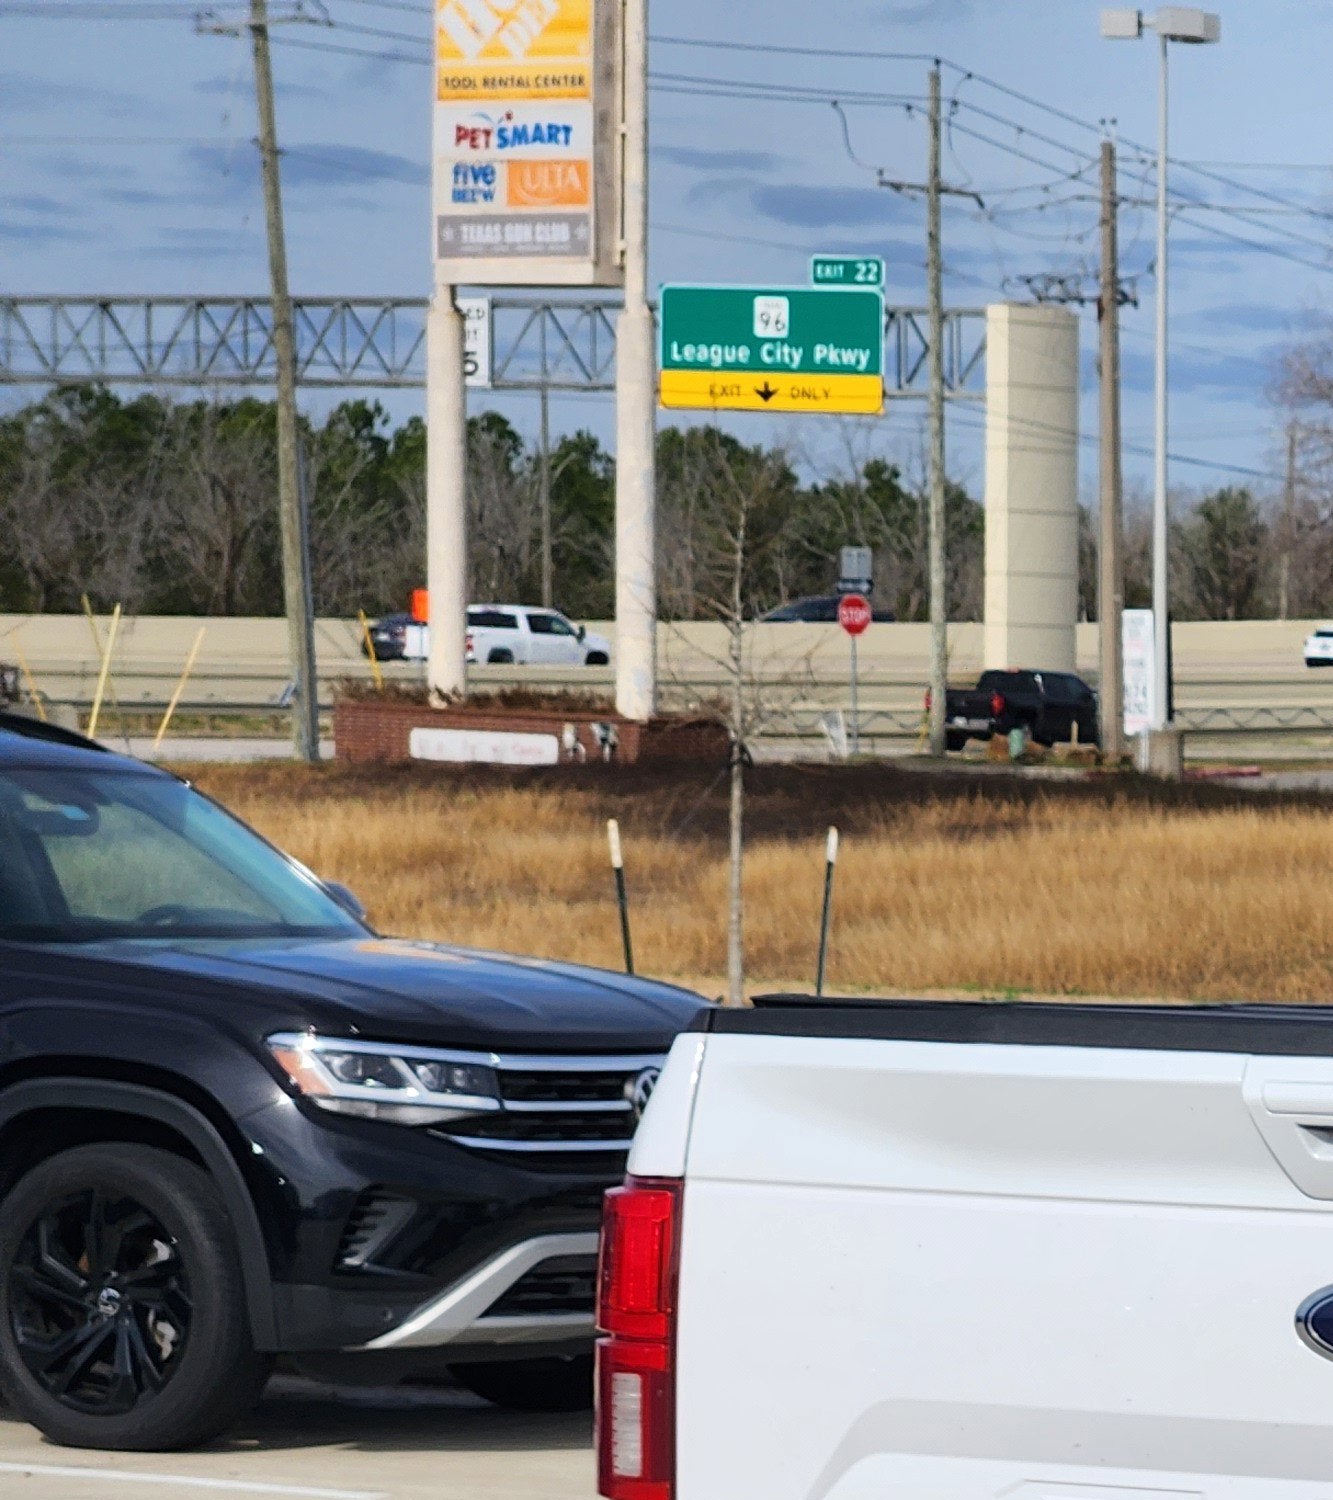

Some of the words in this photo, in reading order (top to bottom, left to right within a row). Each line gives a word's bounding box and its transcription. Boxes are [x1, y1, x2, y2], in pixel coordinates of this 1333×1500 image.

[444, 76, 477, 88] TOOL
[482, 75, 530, 88] RENTAL
[535, 74, 585, 88] CENTER
[815, 264, 844, 279] EXIT
[854, 263, 878, 281] 22
[759, 310, 786, 332] 96
[670, 340, 750, 367] League
[760, 341, 803, 369] City
[813, 343, 871, 370] Pkwy
[709, 383, 741, 398] EXIT
[790, 386, 831, 400] ONLY
[840, 606, 870, 623] STOP
